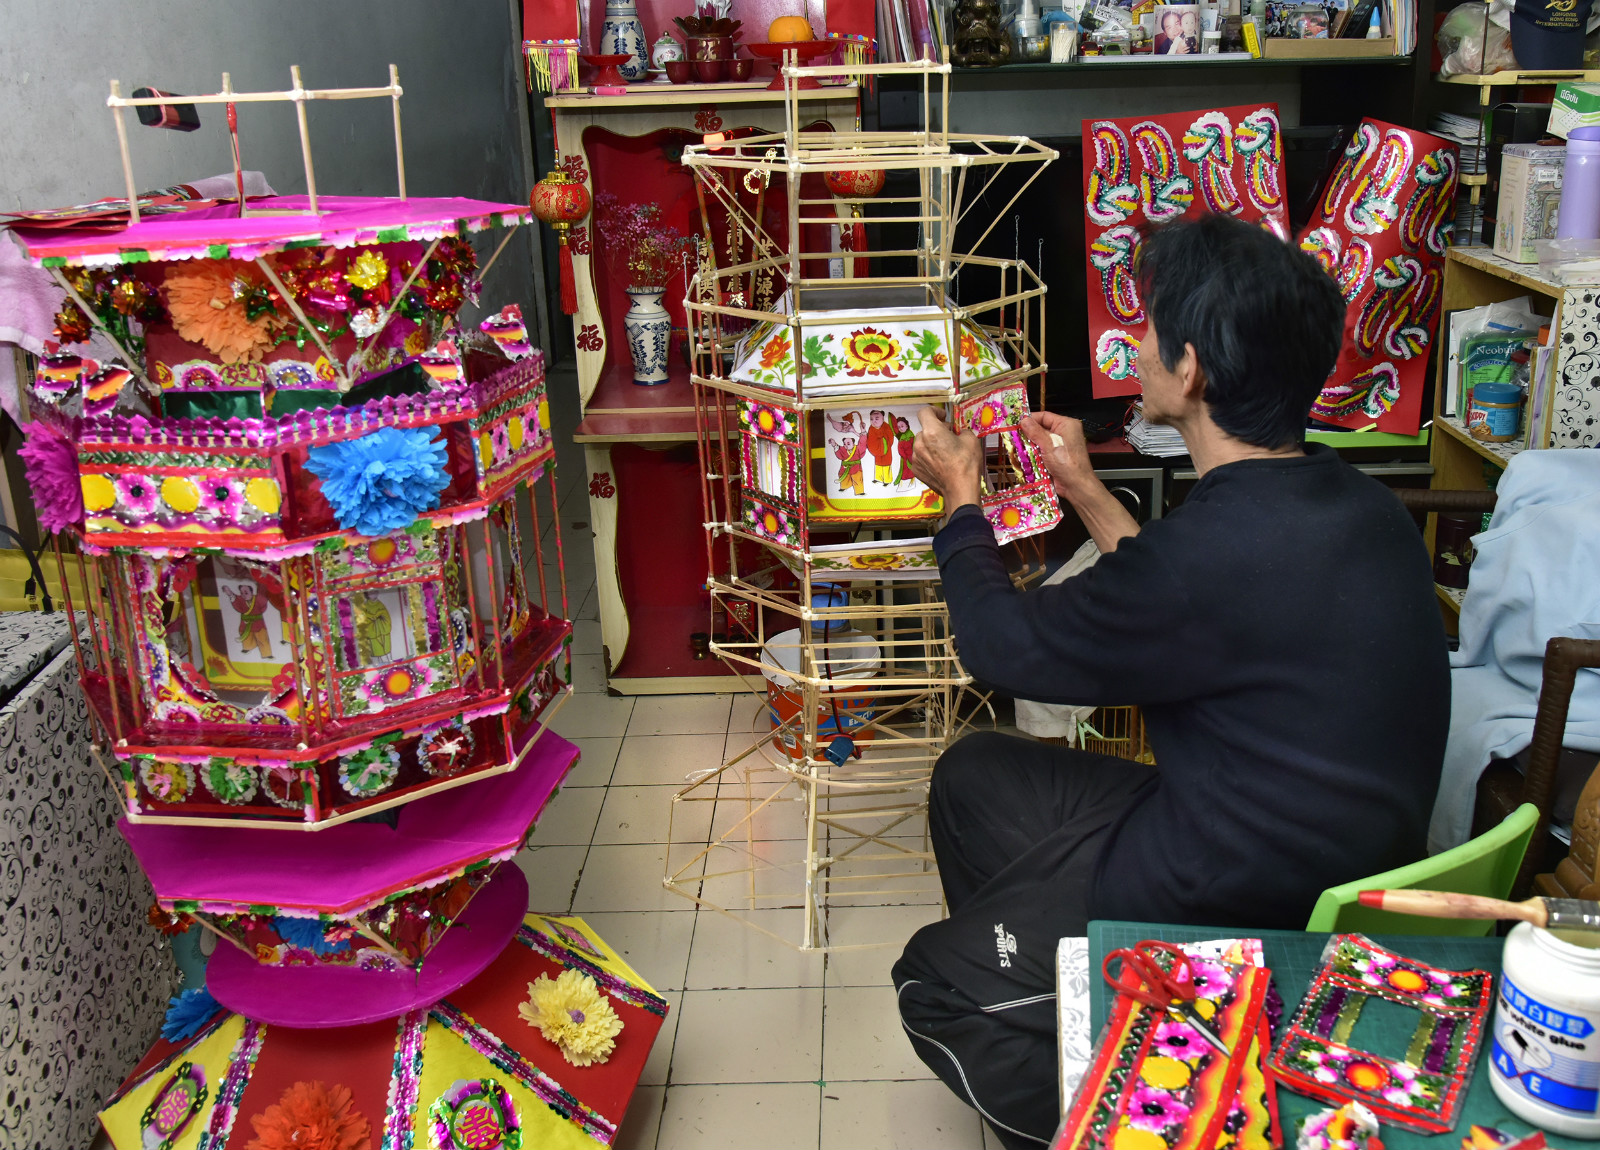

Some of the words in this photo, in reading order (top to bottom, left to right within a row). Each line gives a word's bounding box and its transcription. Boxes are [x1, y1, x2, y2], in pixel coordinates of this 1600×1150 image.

[577, 324, 604, 352] 福
[589, 472, 616, 499] 福
[994, 923, 1011, 968] SPORTS
[1510, 1010, 1546, 1038] white
[1549, 1034, 1587, 1051] glue
[1498, 1053, 1509, 1075] A
[1530, 1075, 1542, 1094] E
